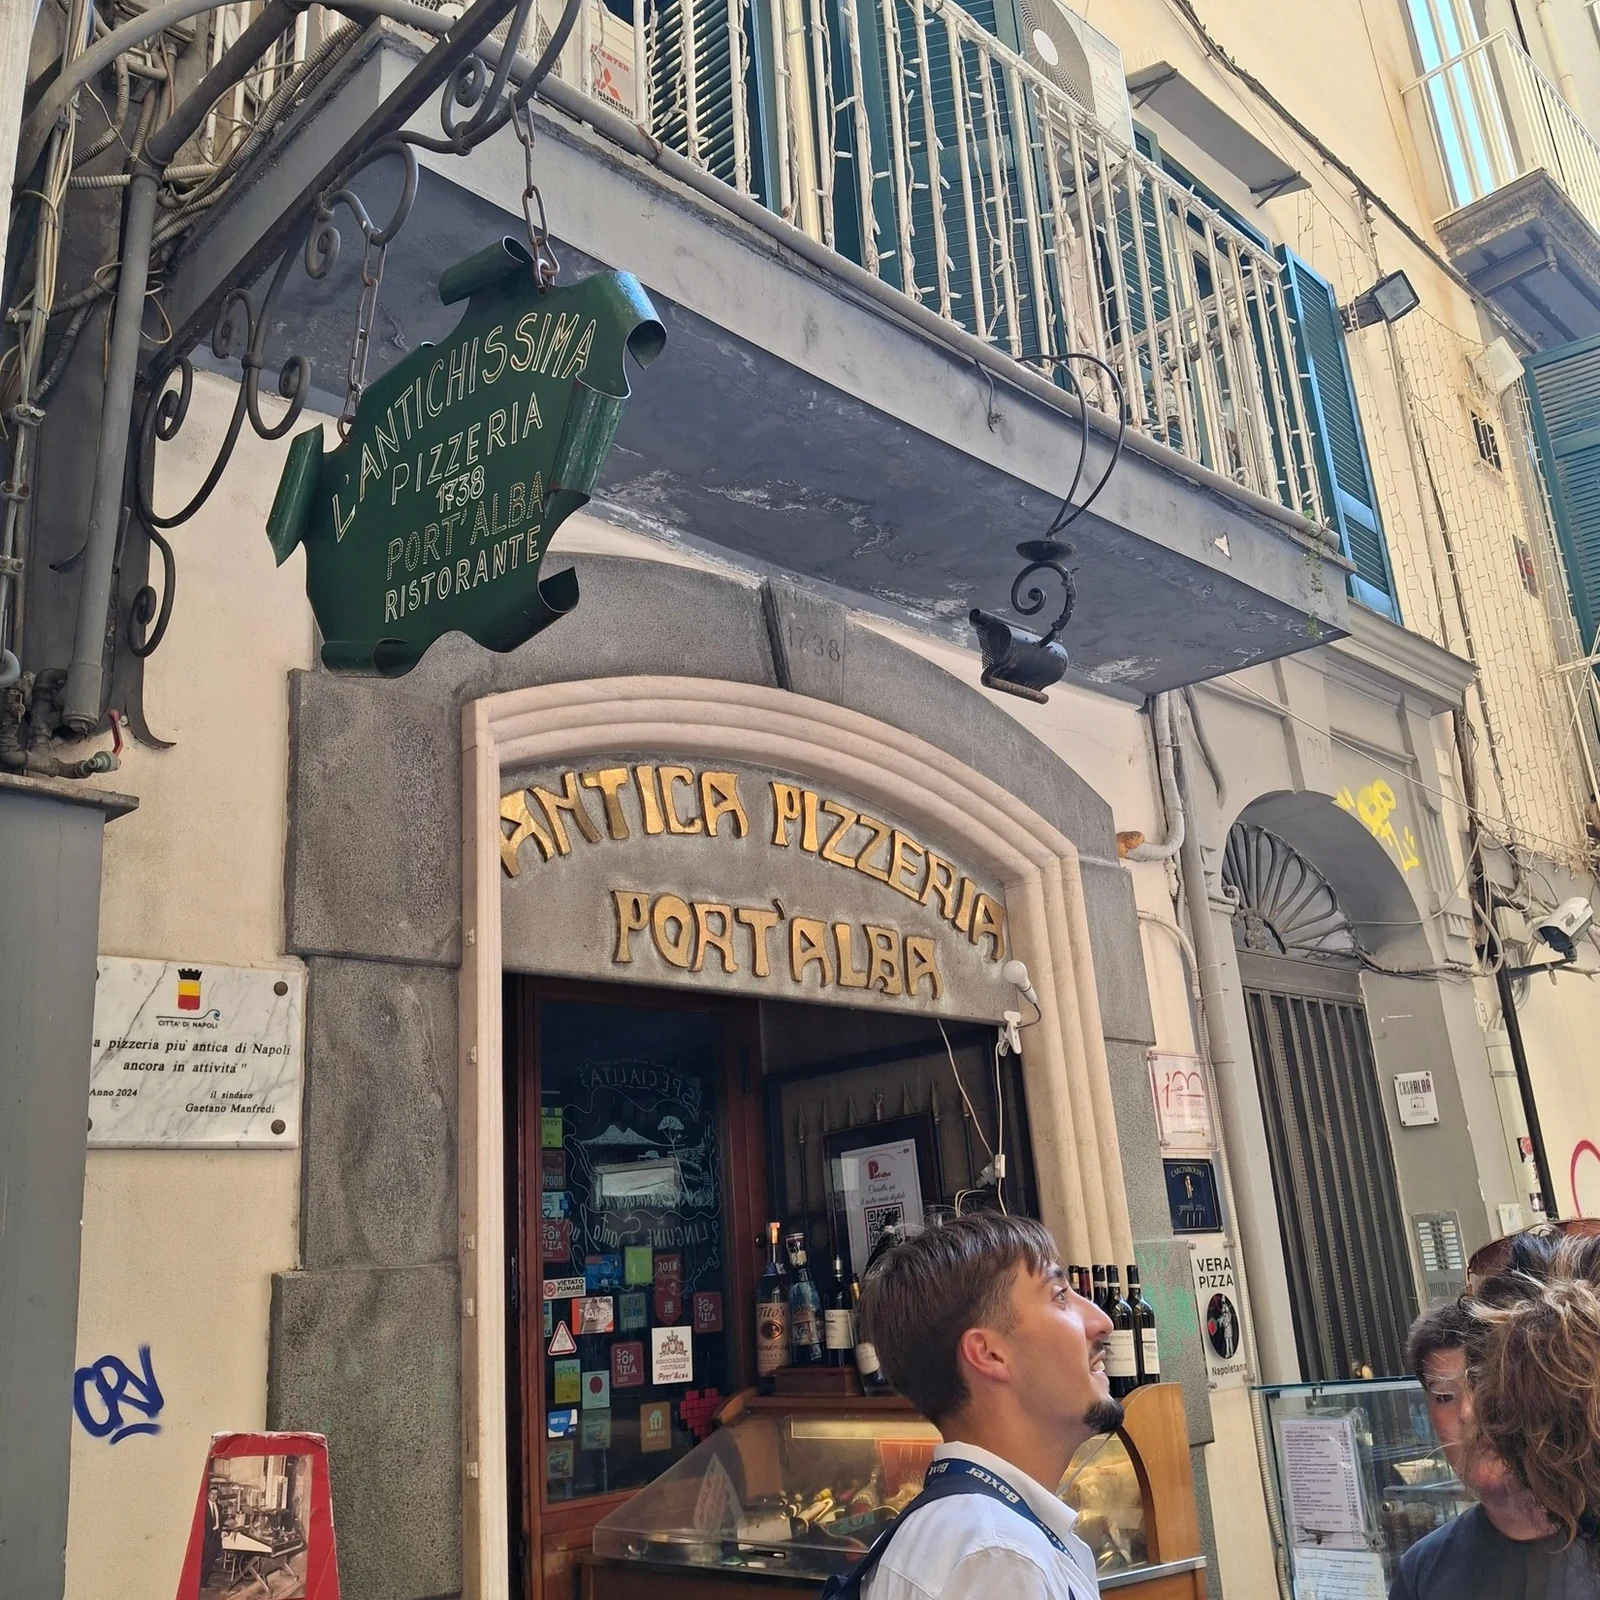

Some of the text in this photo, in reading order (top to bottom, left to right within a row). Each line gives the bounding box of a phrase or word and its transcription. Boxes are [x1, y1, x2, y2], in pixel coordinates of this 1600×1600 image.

[331, 312, 597, 542] L'ANTICHISSIMA
[391, 392, 544, 506] PIZZERIA
[436, 466, 485, 513] 1738
[386, 471, 545, 580] PORT'ALBA
[384, 525, 541, 623] RISTORANTE
[788, 625, 840, 662] 1738
[500, 765, 1006, 963] ANTICA PIZZERIA
[611, 889, 944, 999] PORT'ALBA
[158, 1020, 181, 1028] CITTA'
[192, 1021, 218, 1029] NAPOLI
[108, 1038, 159, 1051] pizzeria
[165, 1039, 188, 1053] più
[192, 1041, 228, 1053] antica
[235, 1041, 247, 1054] di
[252, 1043, 291, 1058] Napoli
[123, 1062, 165, 1071] ancora
[173, 1061, 185, 1072] in
[89, 1088, 138, 1097] Anno 2024
[210, 1091, 253, 1099] il sindaco
[185, 1103, 275, 1114] Gaetano Manfredi
[1196, 1257, 1232, 1274] VERA
[557, 1278, 585, 1286] VIETATO
[1198, 1275, 1235, 1289] PIZZA
[698, 1303, 714, 1312] TOP
[758, 1306, 785, 1318] Tito's
[617, 1356, 634, 1365] TOP
[1211, 1362, 1248, 1377] Napoletana
[965, 1466, 1021, 1504] Baxter
